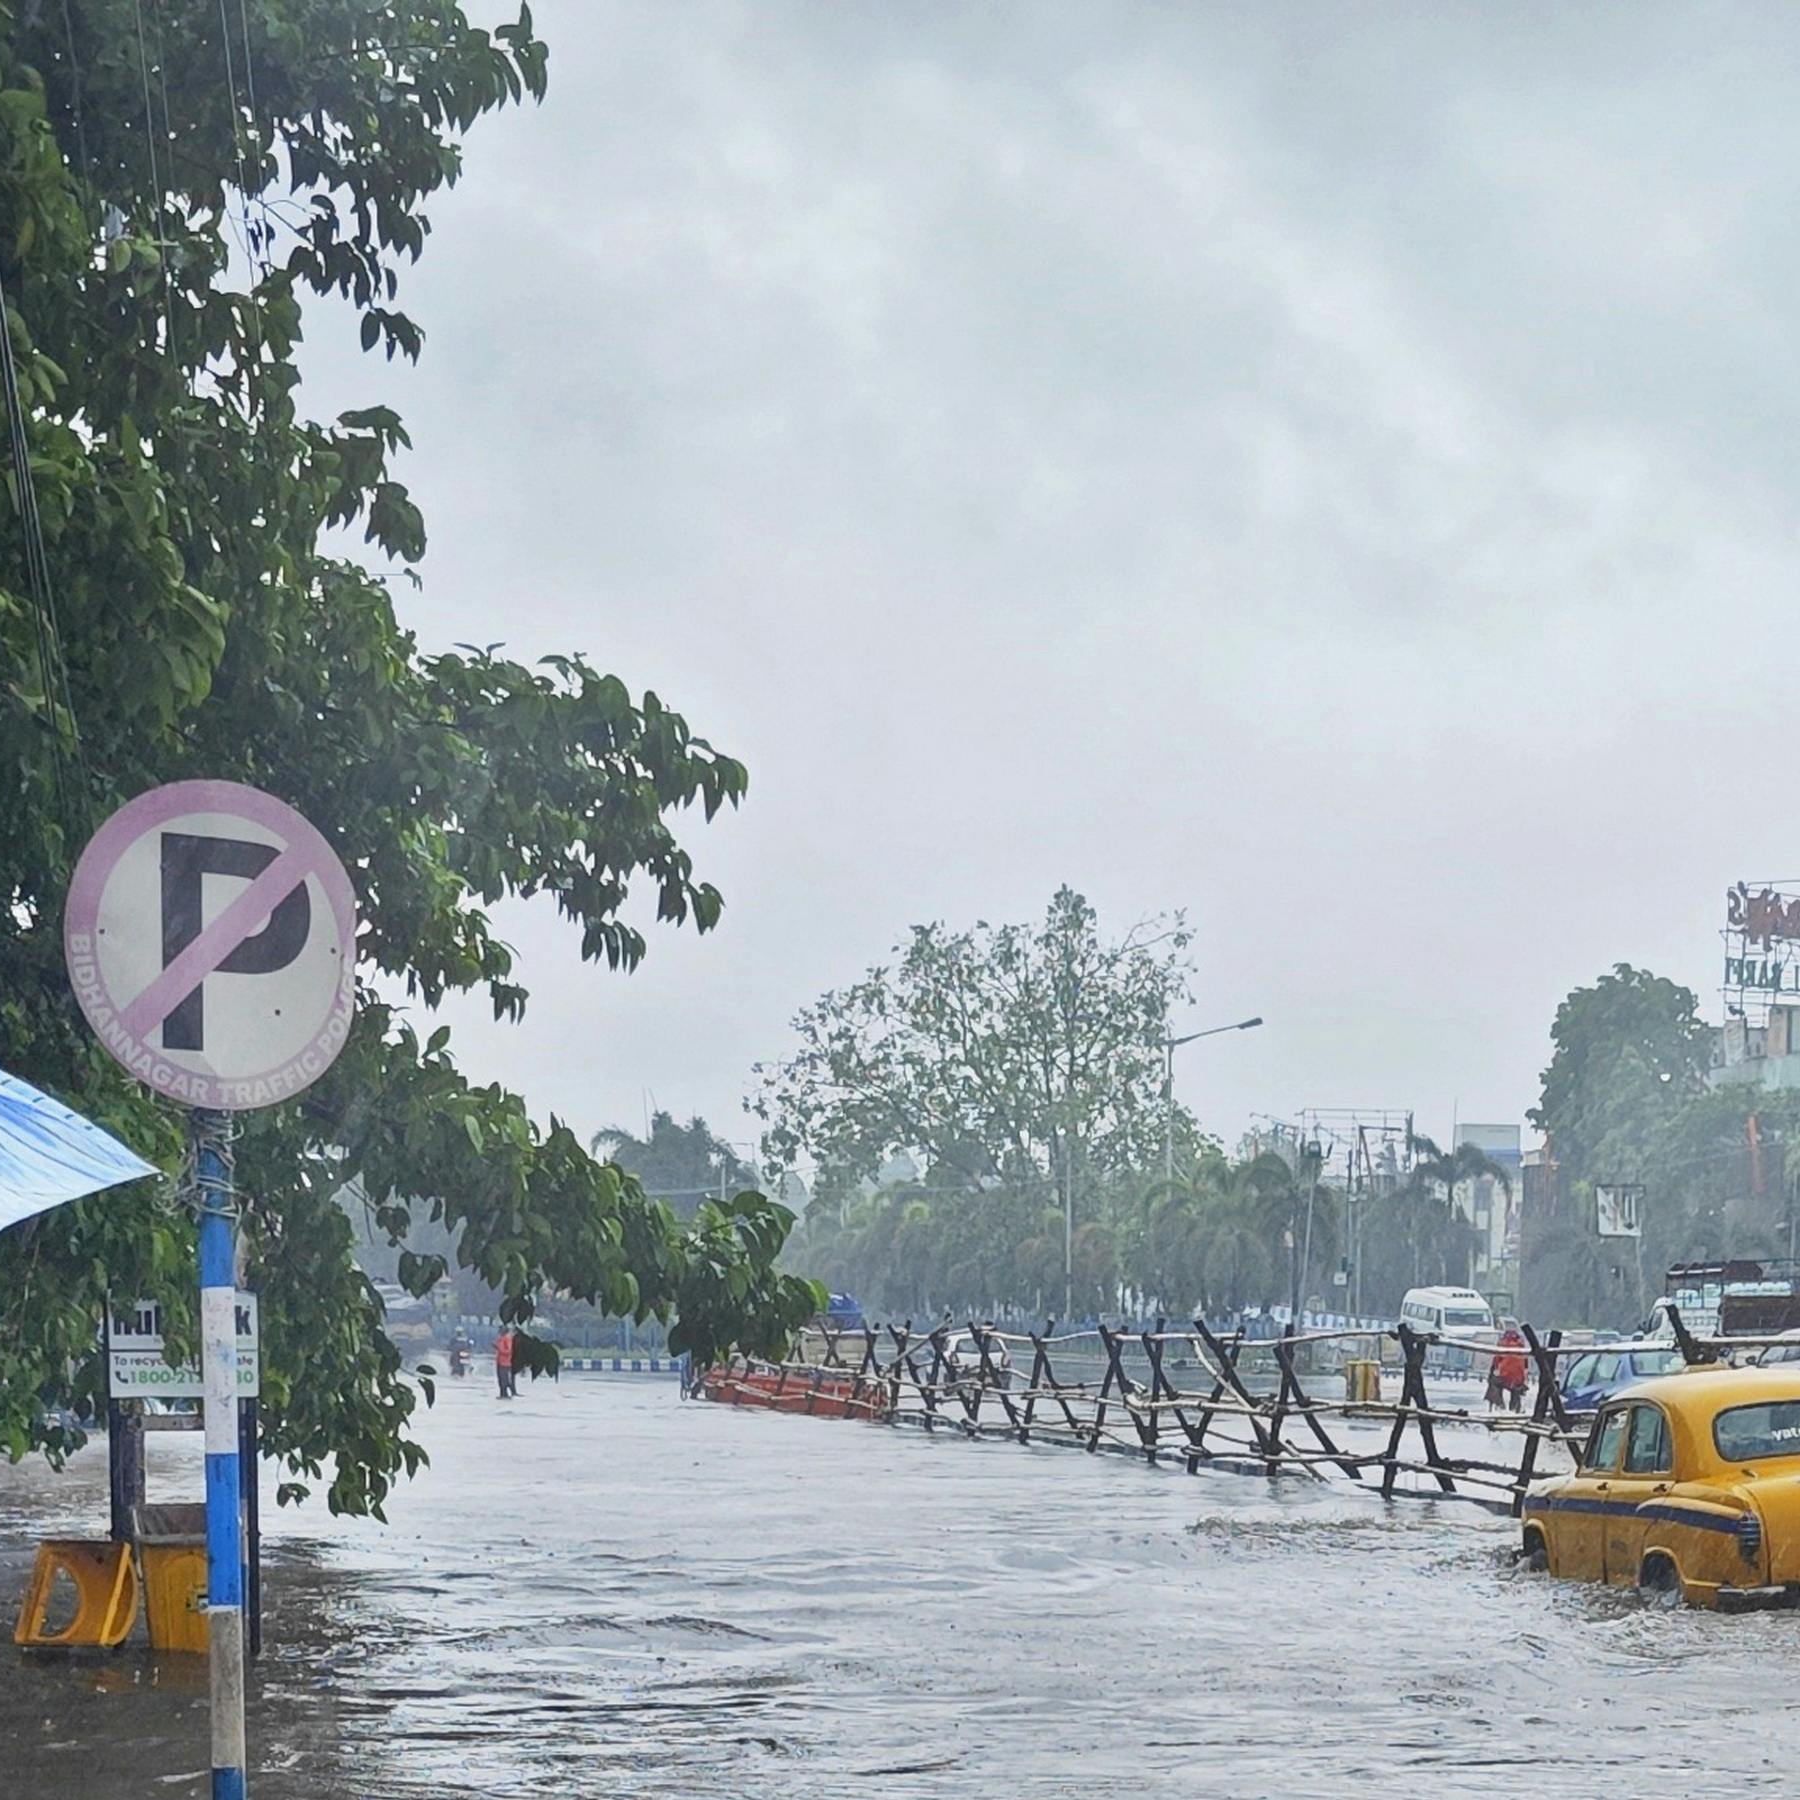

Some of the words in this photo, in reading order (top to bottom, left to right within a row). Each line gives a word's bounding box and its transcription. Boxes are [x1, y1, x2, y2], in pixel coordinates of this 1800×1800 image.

[71, 933, 209, 1100] BIDHANNAGAR
[216, 1050, 322, 1103] TRAFFIC
[160, 831, 311, 1051] P
